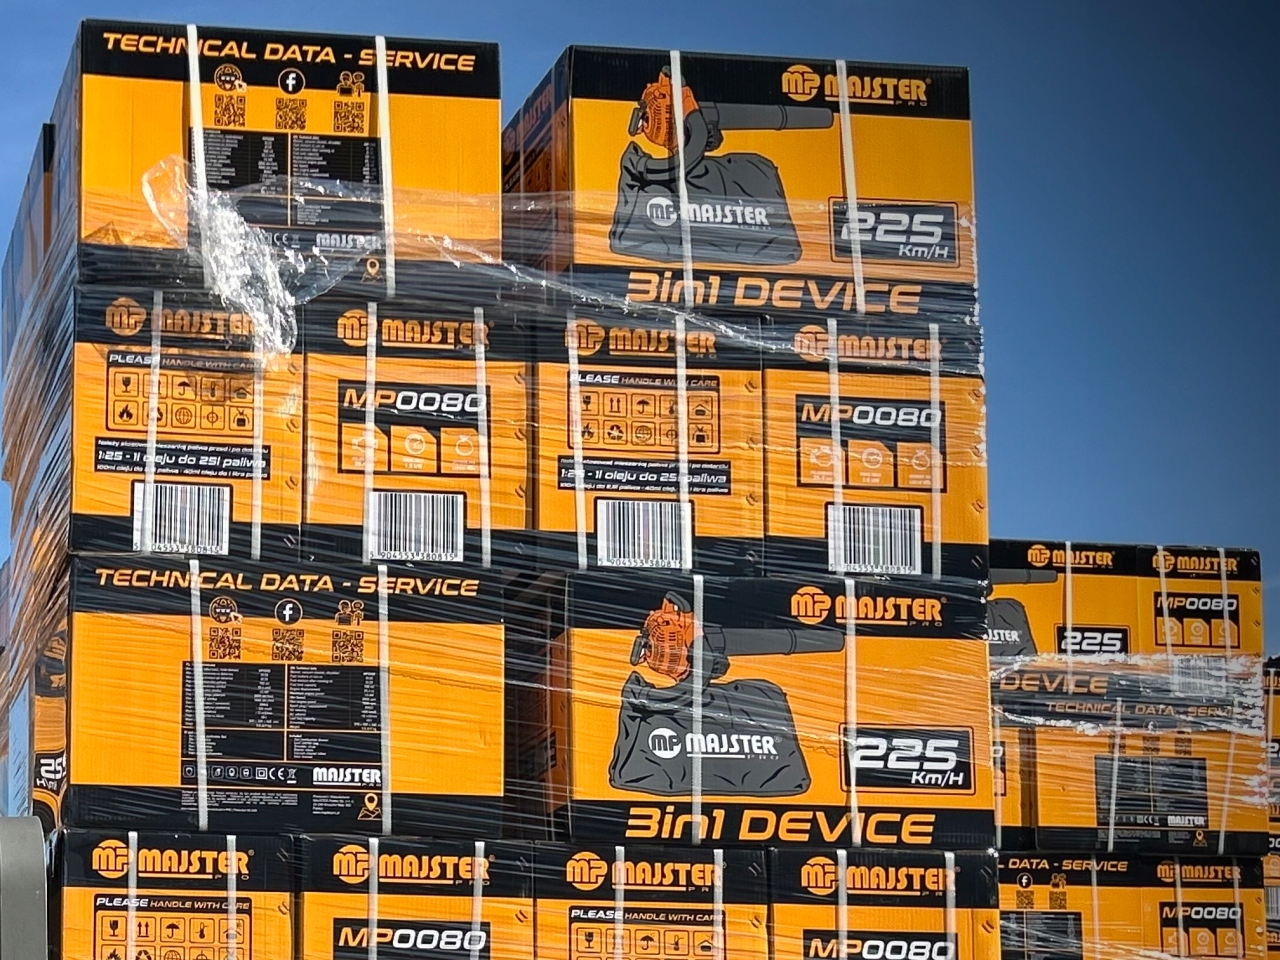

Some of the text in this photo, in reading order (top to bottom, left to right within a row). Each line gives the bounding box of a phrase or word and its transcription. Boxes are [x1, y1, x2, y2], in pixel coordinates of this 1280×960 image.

[264, 43, 336, 64] DATA
[359, 47, 476, 72] SERVICE
[825, 73, 927, 101] MAJSTER
[841, 211, 944, 243] 225
[898, 244, 948, 259] Km/H
[734, 277, 922, 313] DEVICE
[344, 388, 487, 413] MP0080
[801, 403, 941, 427] MP0080
[95, 569, 479, 597] TECHNCAL DATA SERVICE
[835, 596, 943, 620] MAJSTER
[1061, 632, 1122, 651] 225
[999, 675, 1108, 693] DEVICE
[686, 733, 775, 754] MAJSTER
[853, 738, 958, 769] 225
[313, 767, 381, 784] MAJSTER
[911, 771, 964, 786] Km/H
[625, 806, 936, 844] 3in1 DEVICE
[1168, 816, 1206, 825] MAJSTER
[138, 850, 249, 875] MAJSTER
[379, 855, 489, 881] MAJSTER
[1008, 860, 1127, 871] DATA SERVICE
[96, 898, 219, 909] PLEASE HANDLE WITH
[571, 910, 693, 922] PLEASE HANDLE WITH
[339, 927, 487, 950] MP0080
[809, 938, 955, 960] MP0080
